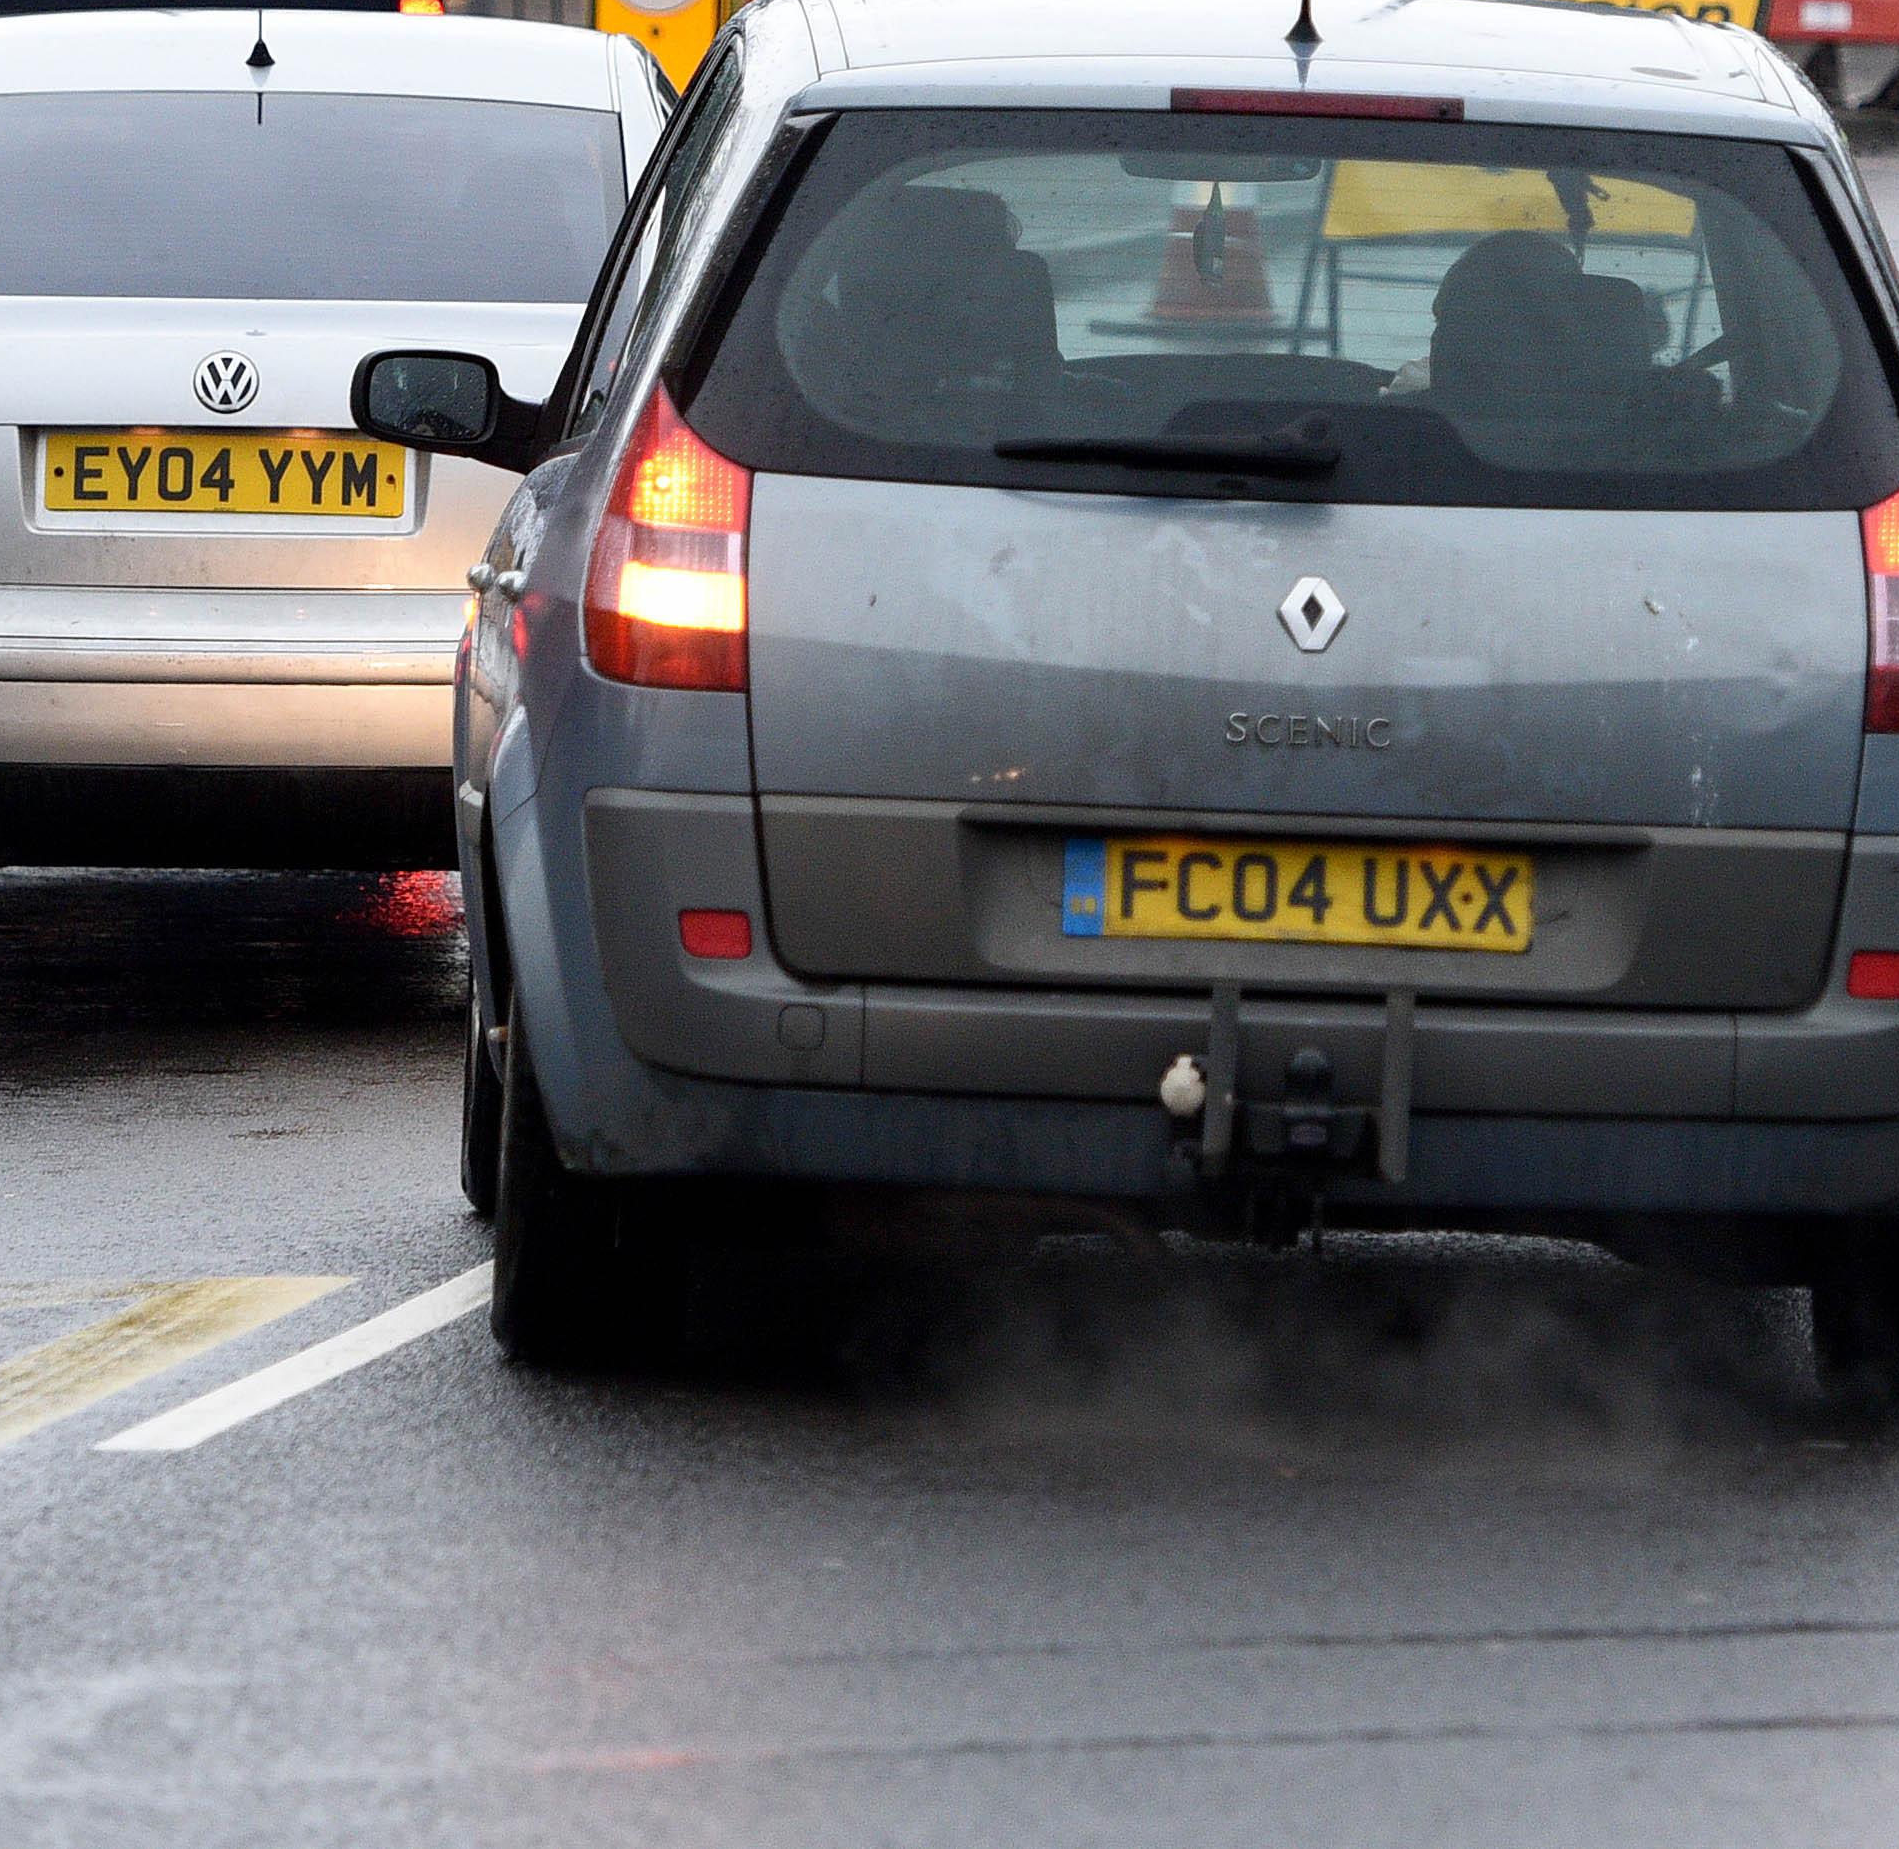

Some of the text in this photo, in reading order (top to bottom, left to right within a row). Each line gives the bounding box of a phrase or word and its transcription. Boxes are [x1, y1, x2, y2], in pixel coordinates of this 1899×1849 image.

[73, 446, 377, 507] EY04 YYM
[1225, 711, 1391, 749] SCENIC
[1120, 850, 1518, 936] FC04 UXX
